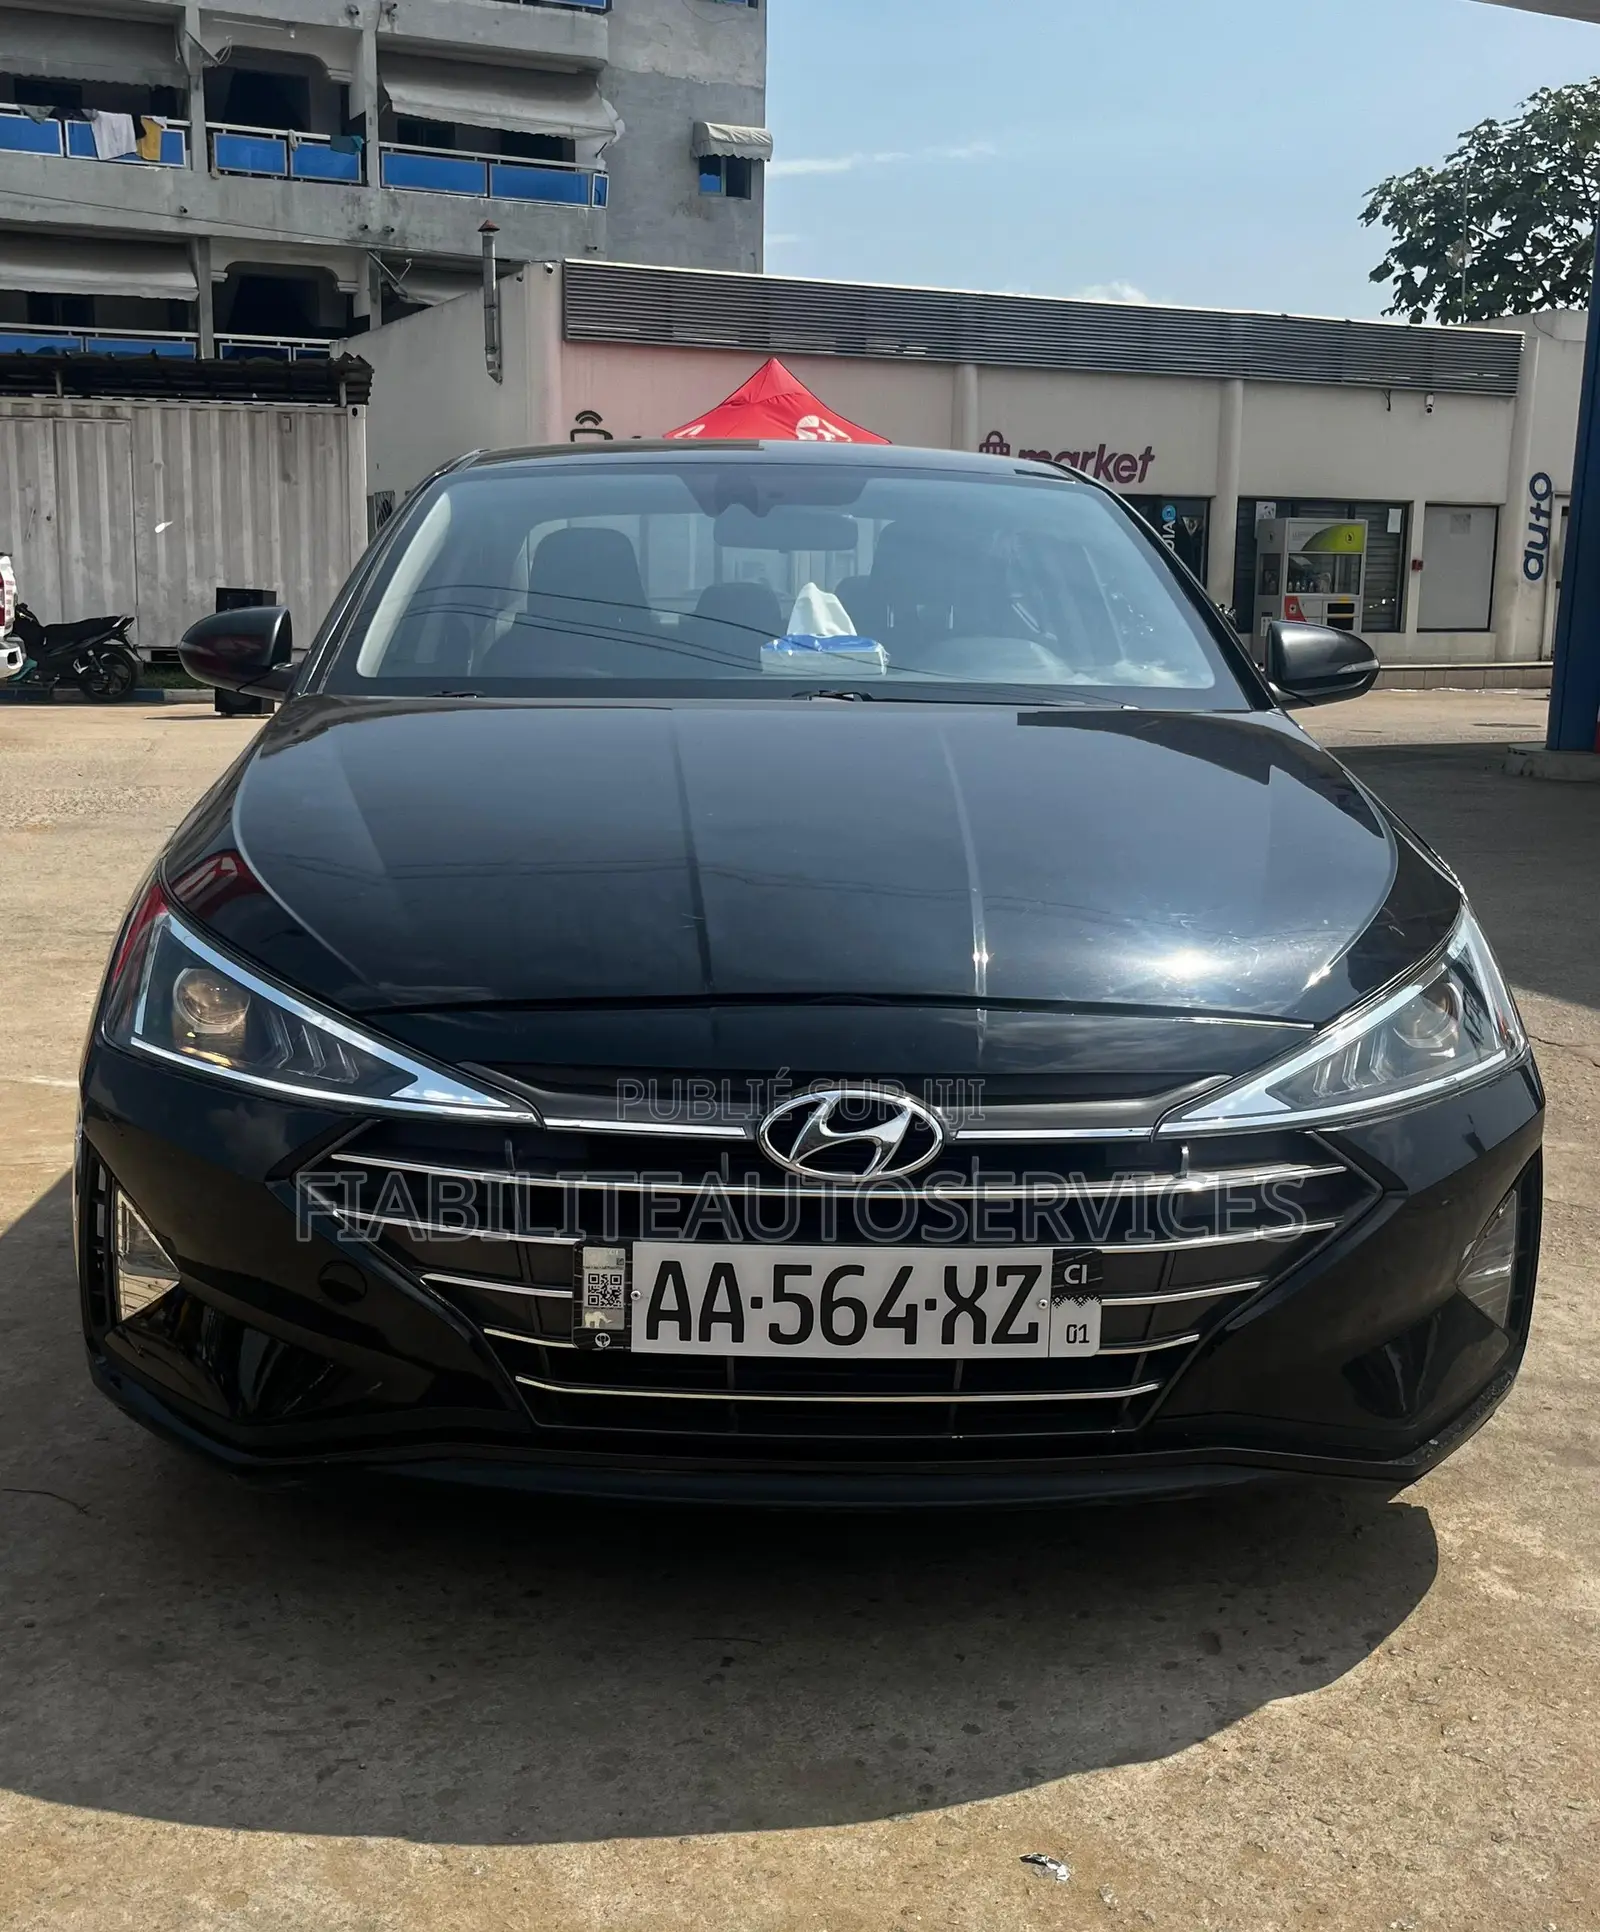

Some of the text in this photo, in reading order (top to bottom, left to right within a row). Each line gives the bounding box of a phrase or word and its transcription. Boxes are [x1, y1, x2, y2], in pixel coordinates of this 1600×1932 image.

[1523, 472, 1552, 581] auto
[1064, 1264, 1088, 1285] CI
[1066, 1323, 1090, 1344] 01
